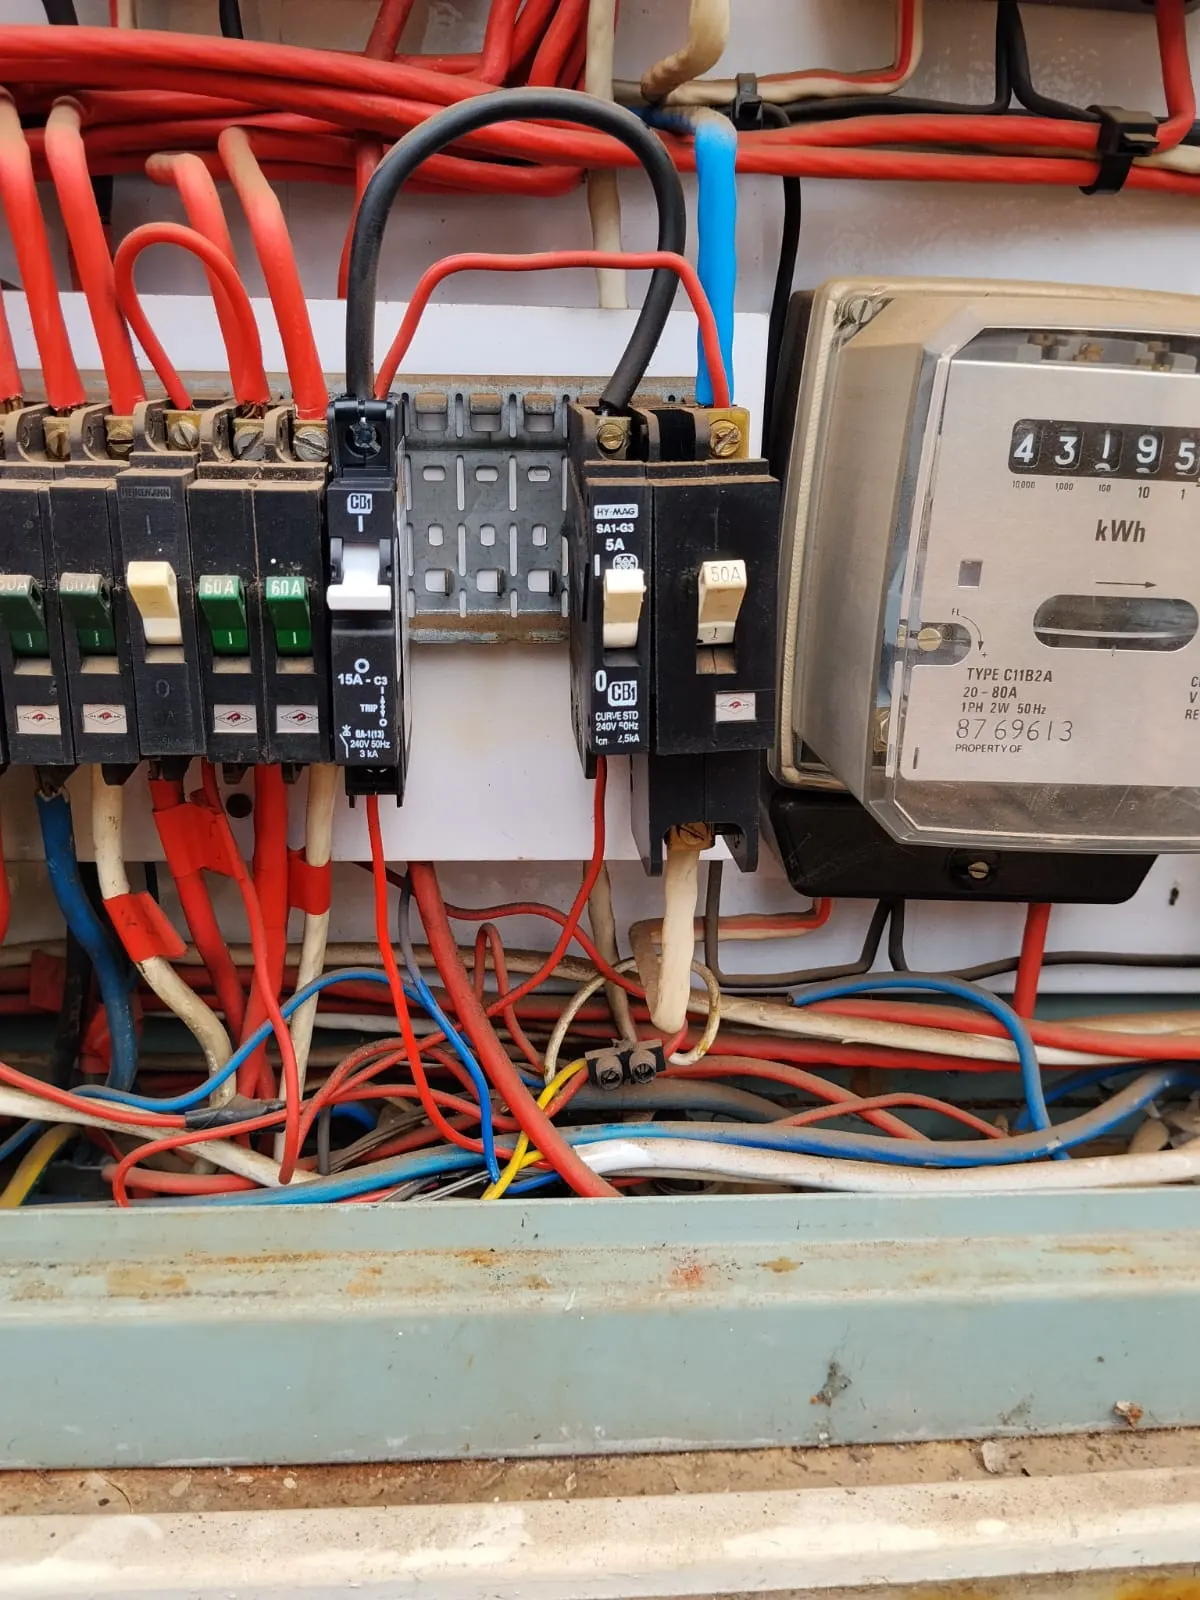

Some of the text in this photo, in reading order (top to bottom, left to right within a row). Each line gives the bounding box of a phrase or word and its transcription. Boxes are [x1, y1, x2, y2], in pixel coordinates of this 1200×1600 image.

[1098, 484, 1111, 492] 100
[1138, 486, 1150, 499] 10
[1095, 519, 1146, 543] kWh
[605, 537, 625, 552] 5A
[710, 566, 742, 583] 50A
[204, 579, 235, 595] 60A
[271, 579, 302, 596] 60A
[337, 673, 364, 686] 15A
[373, 676, 388, 686] C3
[967, 667, 1053, 682] TYPE C11B2A
[1190, 675, 1200, 688] C
[963, 686, 979, 698] 20
[991, 686, 1017, 699] 80A
[359, 703, 379, 713] TRIP
[961, 701, 1047, 714] 1PH 2W 50Hz
[595, 711, 639, 721] CURVE STD
[595, 723, 616, 731] 240V
[956, 718, 1074, 742] 8769613
[350, 740, 391, 749] 240V 50Hz
[955, 743, 1023, 753] PROPERTY OF
[359, 749, 366, 758] 3
